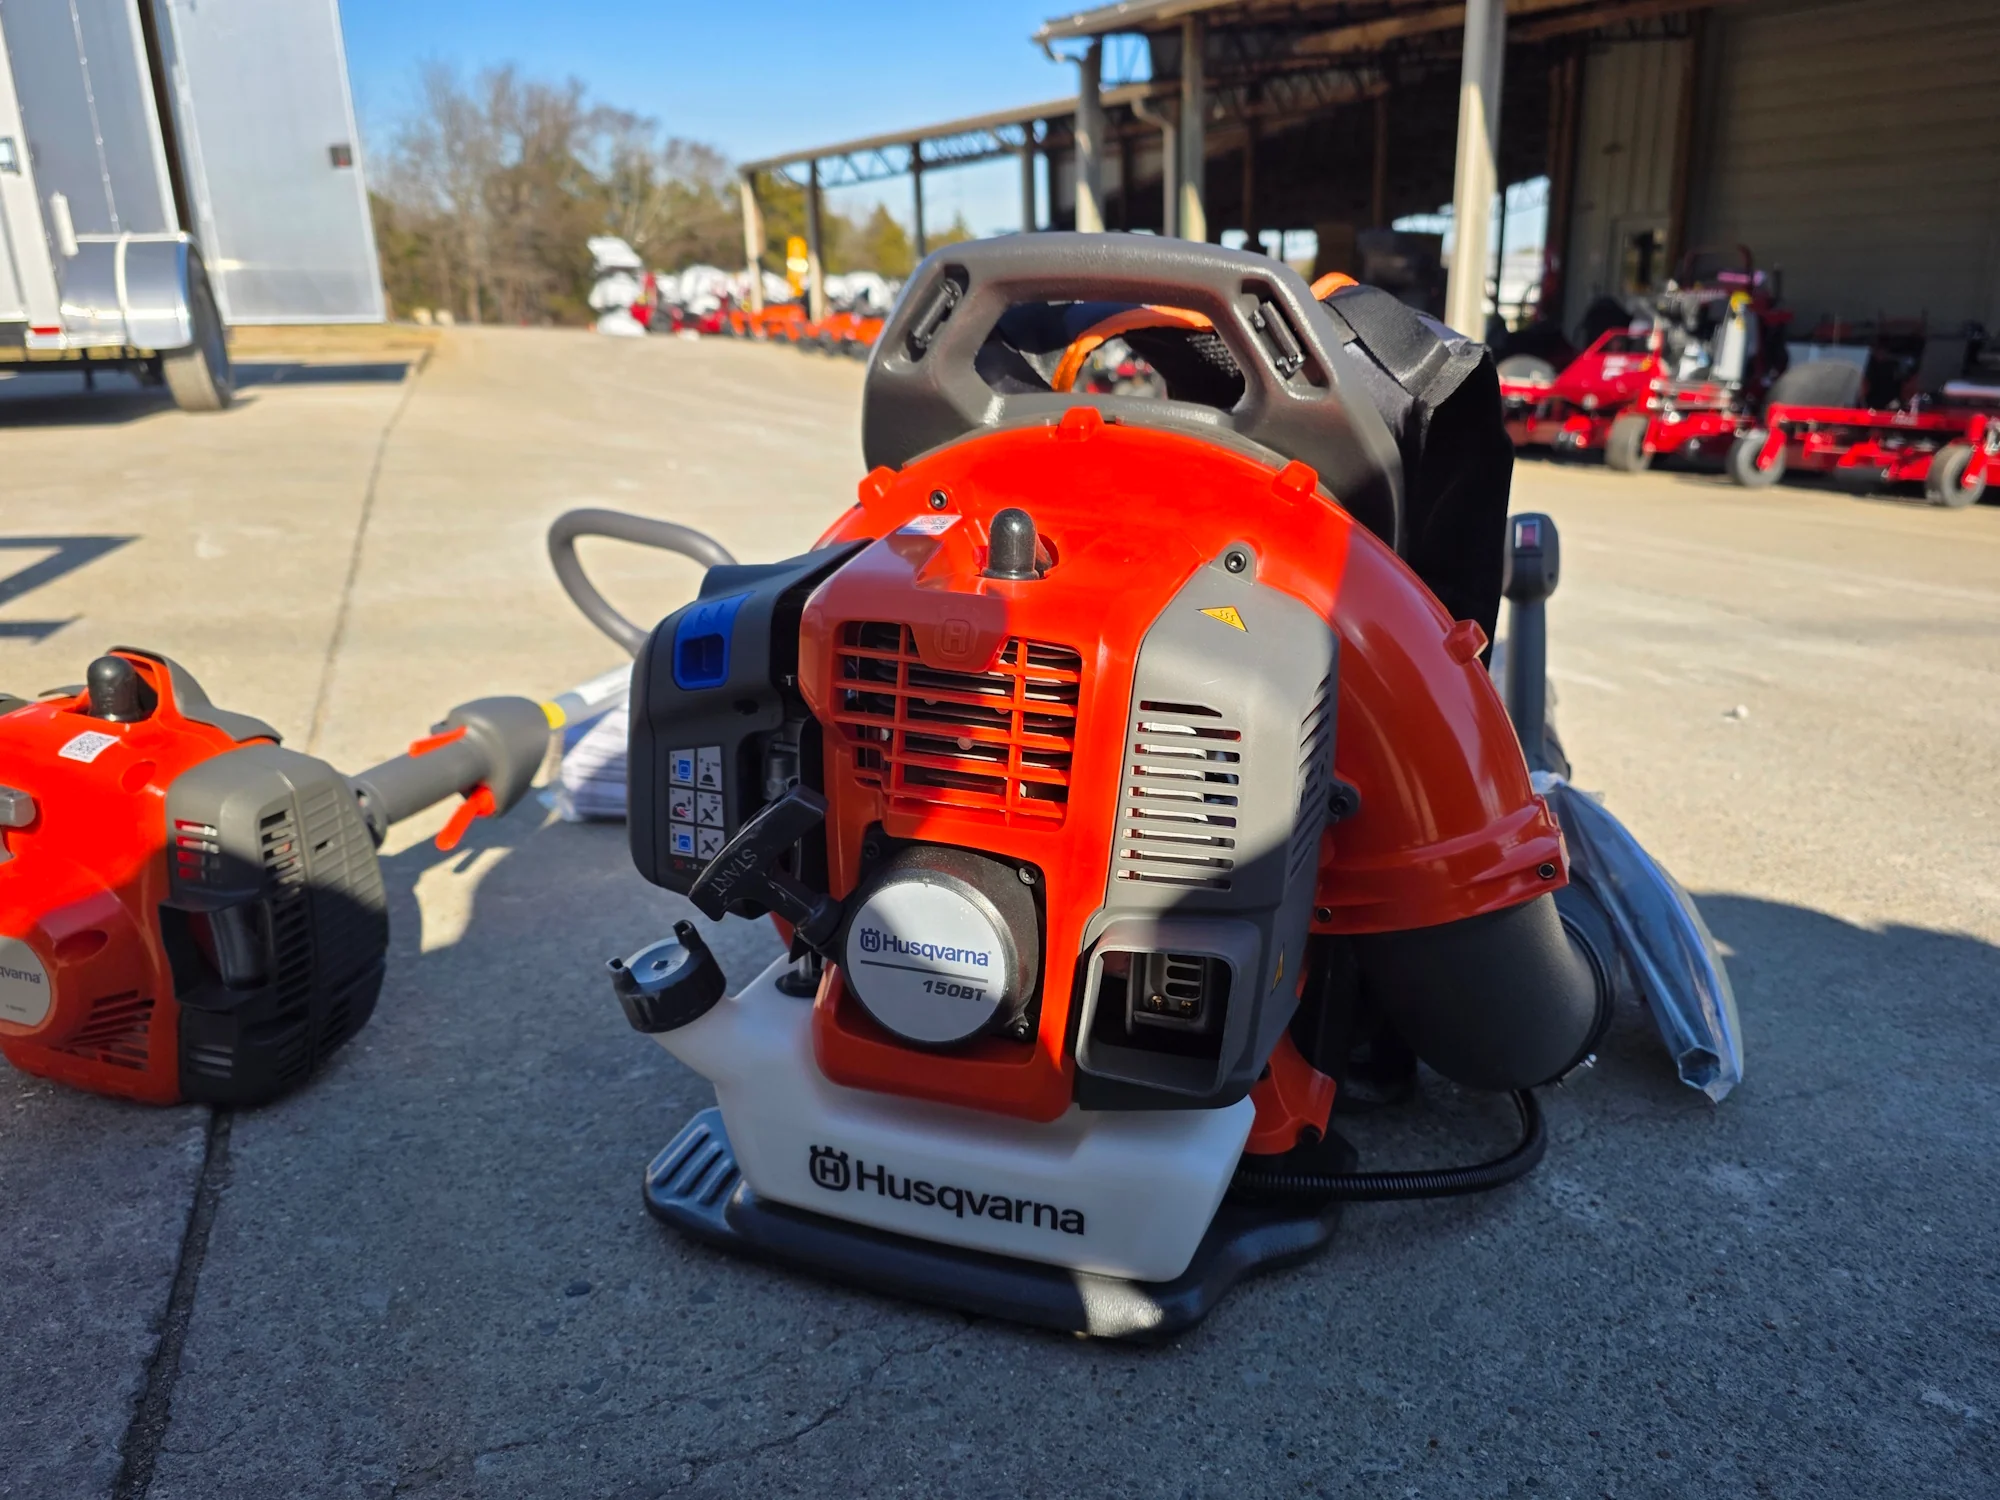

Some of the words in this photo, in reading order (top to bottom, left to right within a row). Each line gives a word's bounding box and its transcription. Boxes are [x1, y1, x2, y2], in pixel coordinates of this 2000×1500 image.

[710, 848, 758, 897] START
[882, 933, 989, 967] Husqvarna
[922, 980, 987, 1002] 150BT
[855, 1159, 1086, 1236] Husqvarna
